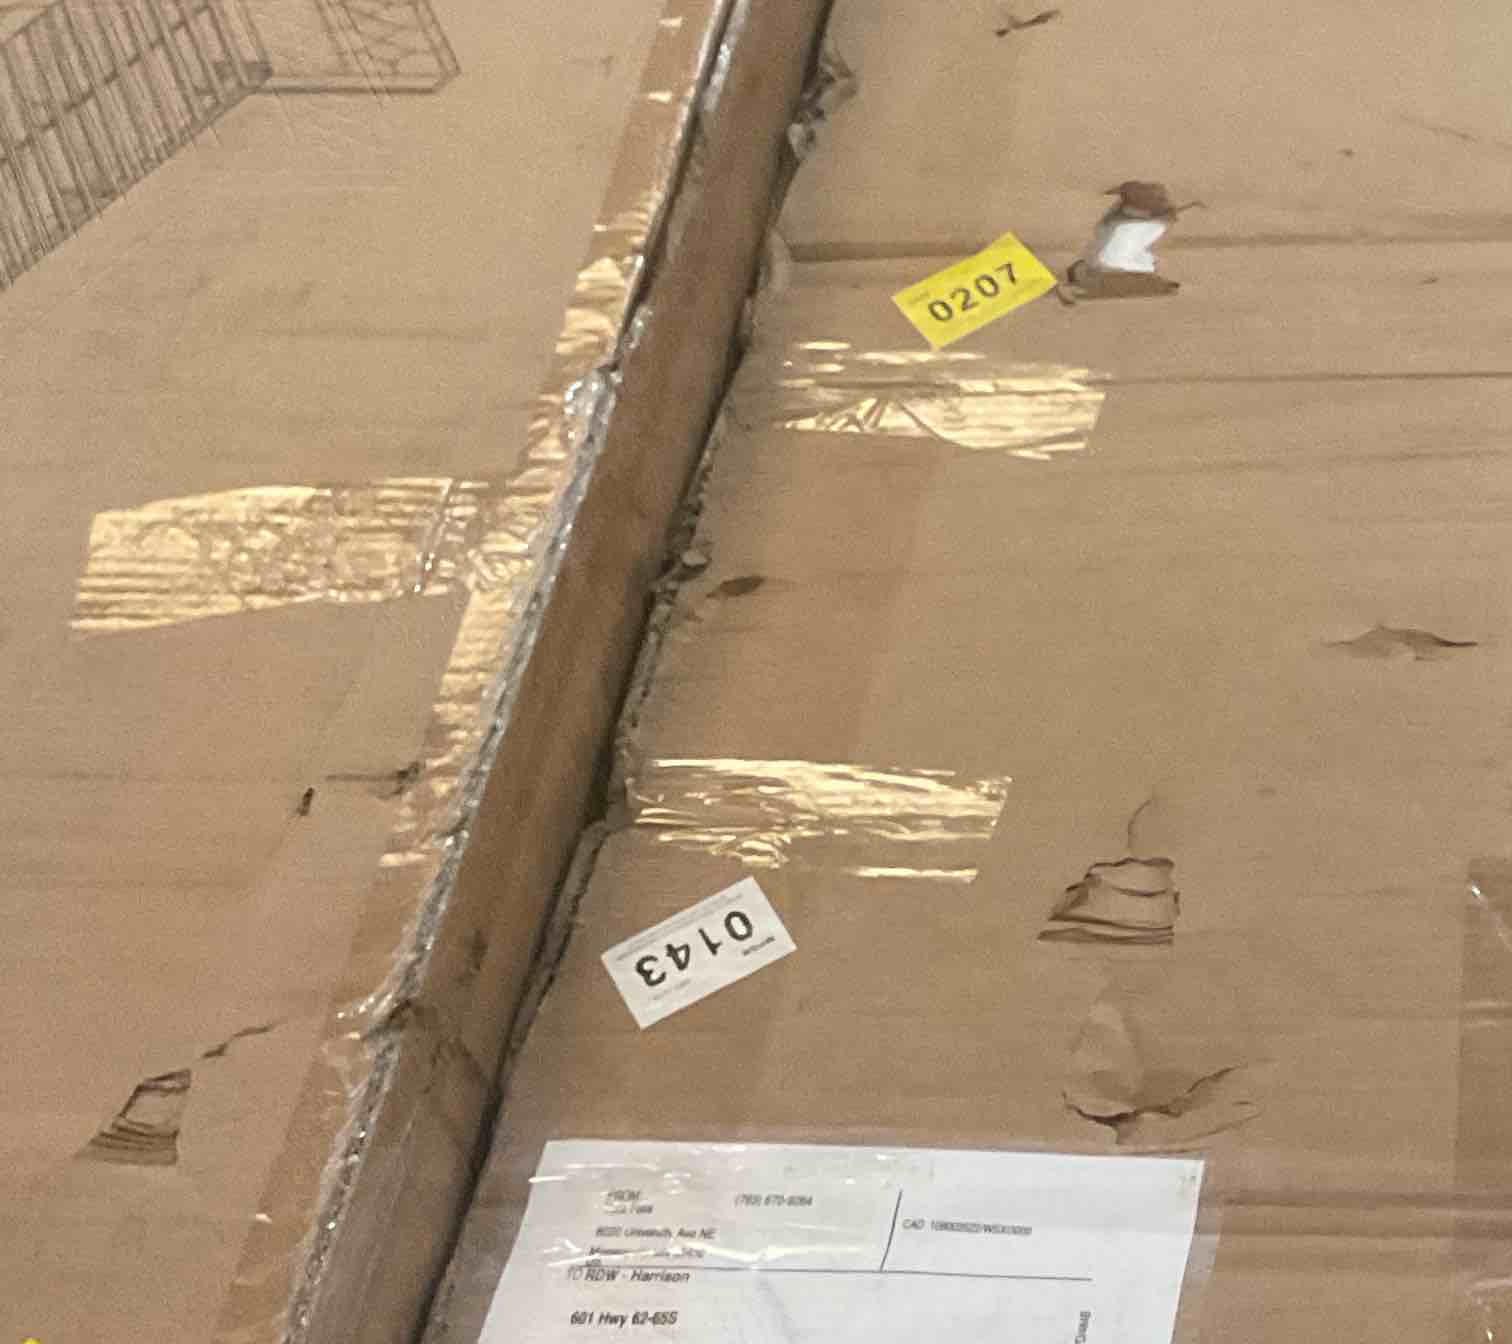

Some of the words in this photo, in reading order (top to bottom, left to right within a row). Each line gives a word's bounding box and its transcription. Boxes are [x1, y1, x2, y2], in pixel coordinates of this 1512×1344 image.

[928, 262, 1017, 322] 0207
[635, 910, 753, 986] 0143
[631, 1269, 690, 1284] Harrison
[570, 1312, 594, 1326] 601
[598, 1312, 627, 1330] Hwy
